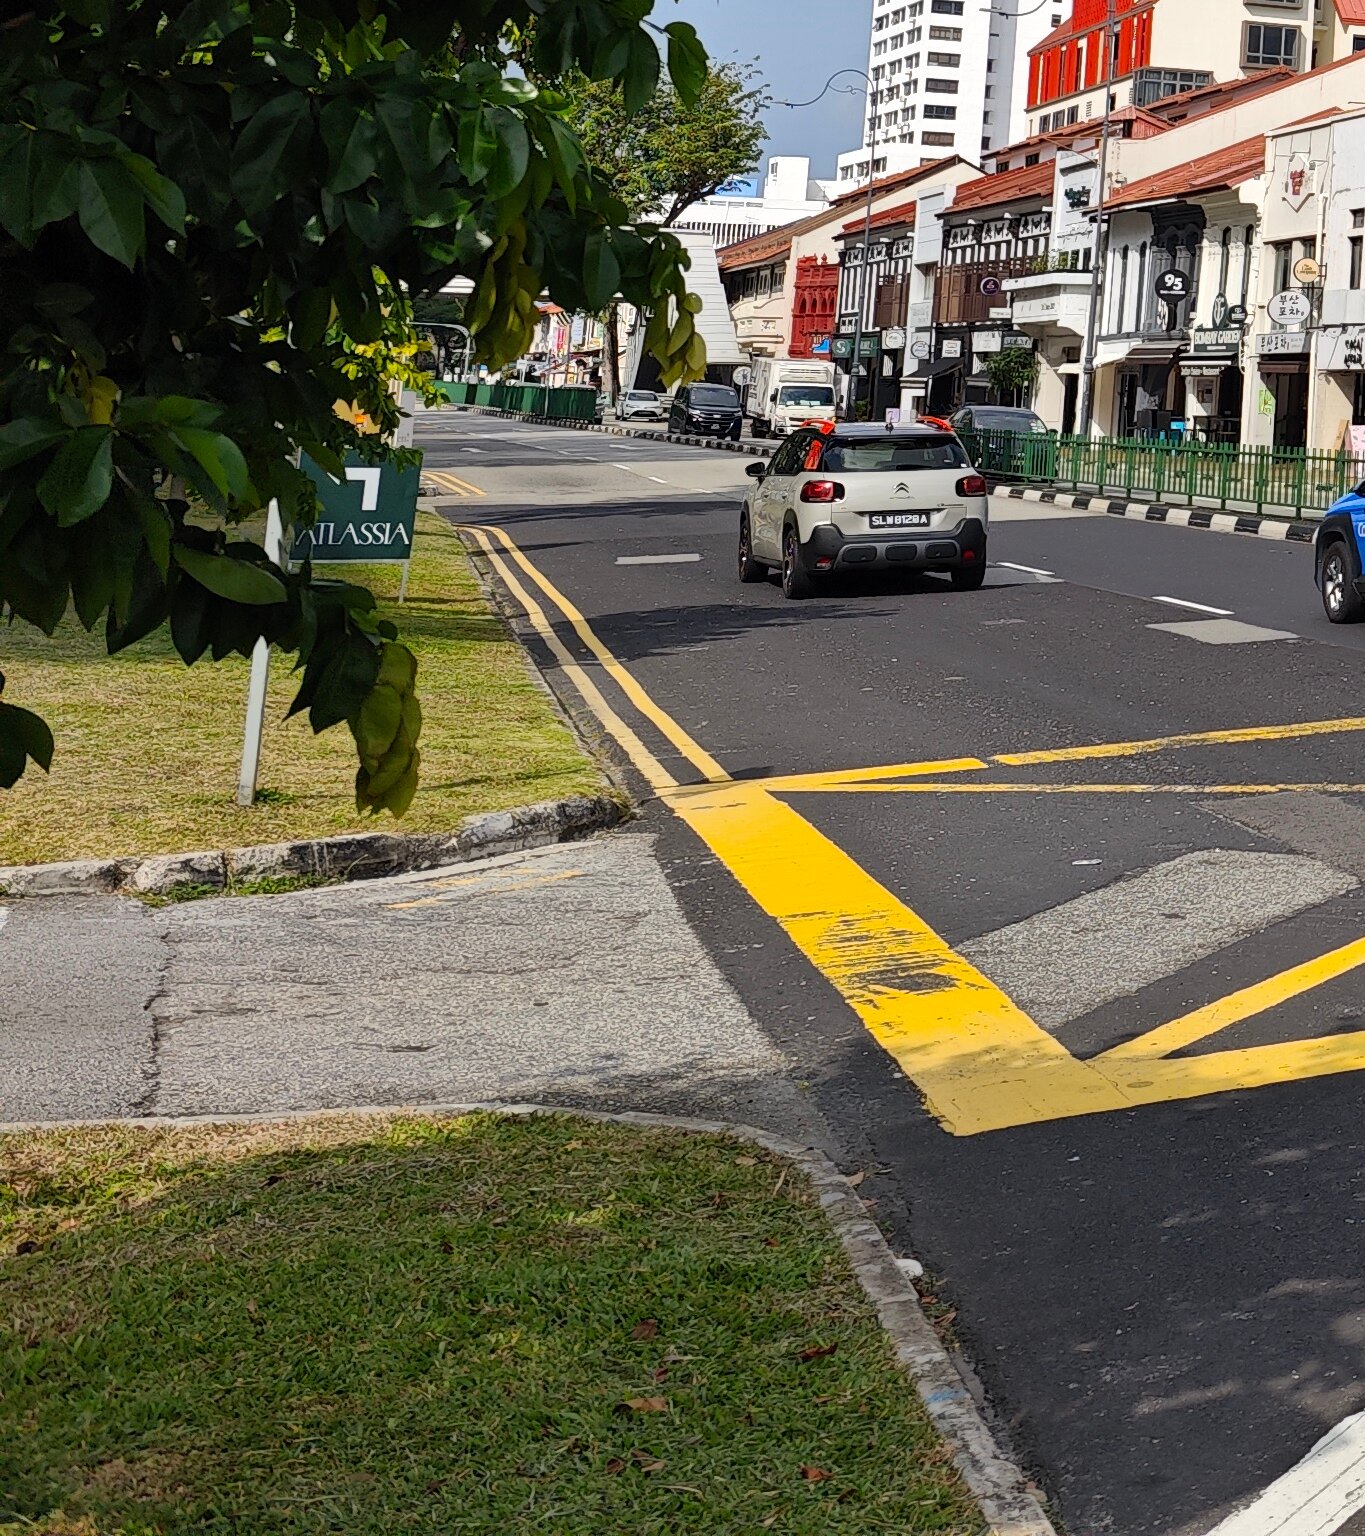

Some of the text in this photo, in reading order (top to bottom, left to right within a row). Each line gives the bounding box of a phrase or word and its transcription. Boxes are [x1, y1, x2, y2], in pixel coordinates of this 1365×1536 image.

[1164, 273, 1183, 291] 95
[1279, 295, 1299, 306] 부산
[1278, 306, 1300, 317] 포차
[296, 522, 409, 545] ATLASSIA
